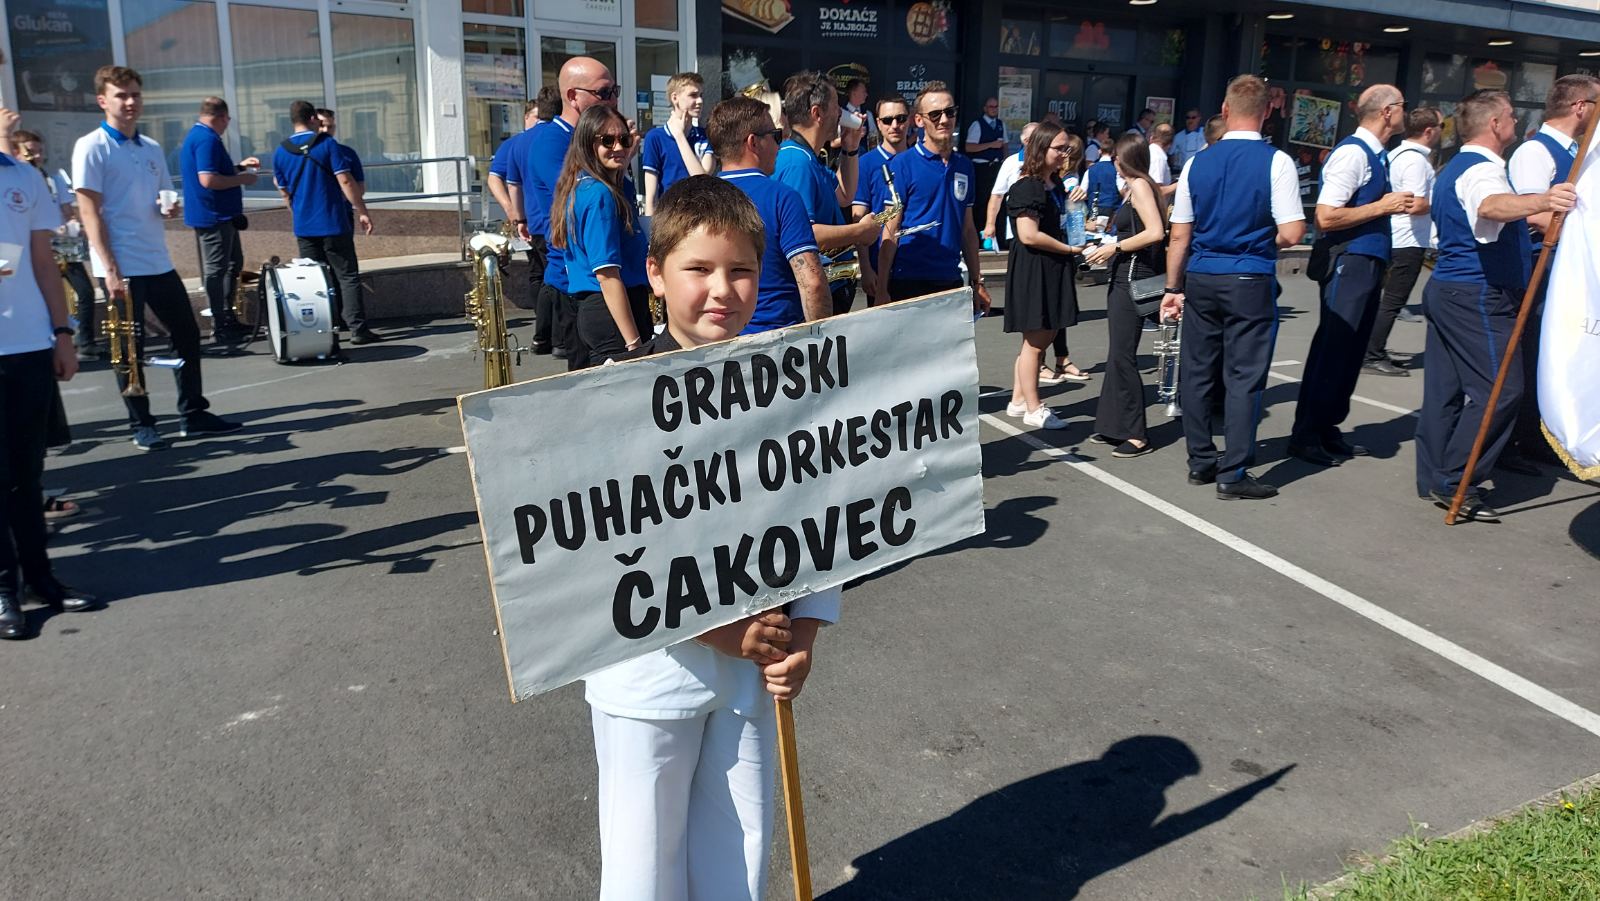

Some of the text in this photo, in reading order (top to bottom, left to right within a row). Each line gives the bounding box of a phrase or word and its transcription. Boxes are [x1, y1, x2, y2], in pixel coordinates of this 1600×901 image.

[14, 15, 73, 33] Glukan
[819, 6, 878, 22] DOMAĆE
[652, 335, 849, 432] GRADSKI
[513, 390, 964, 564] PUHAČKI ORKESTAR
[612, 486, 917, 639] ČAKOVEC
